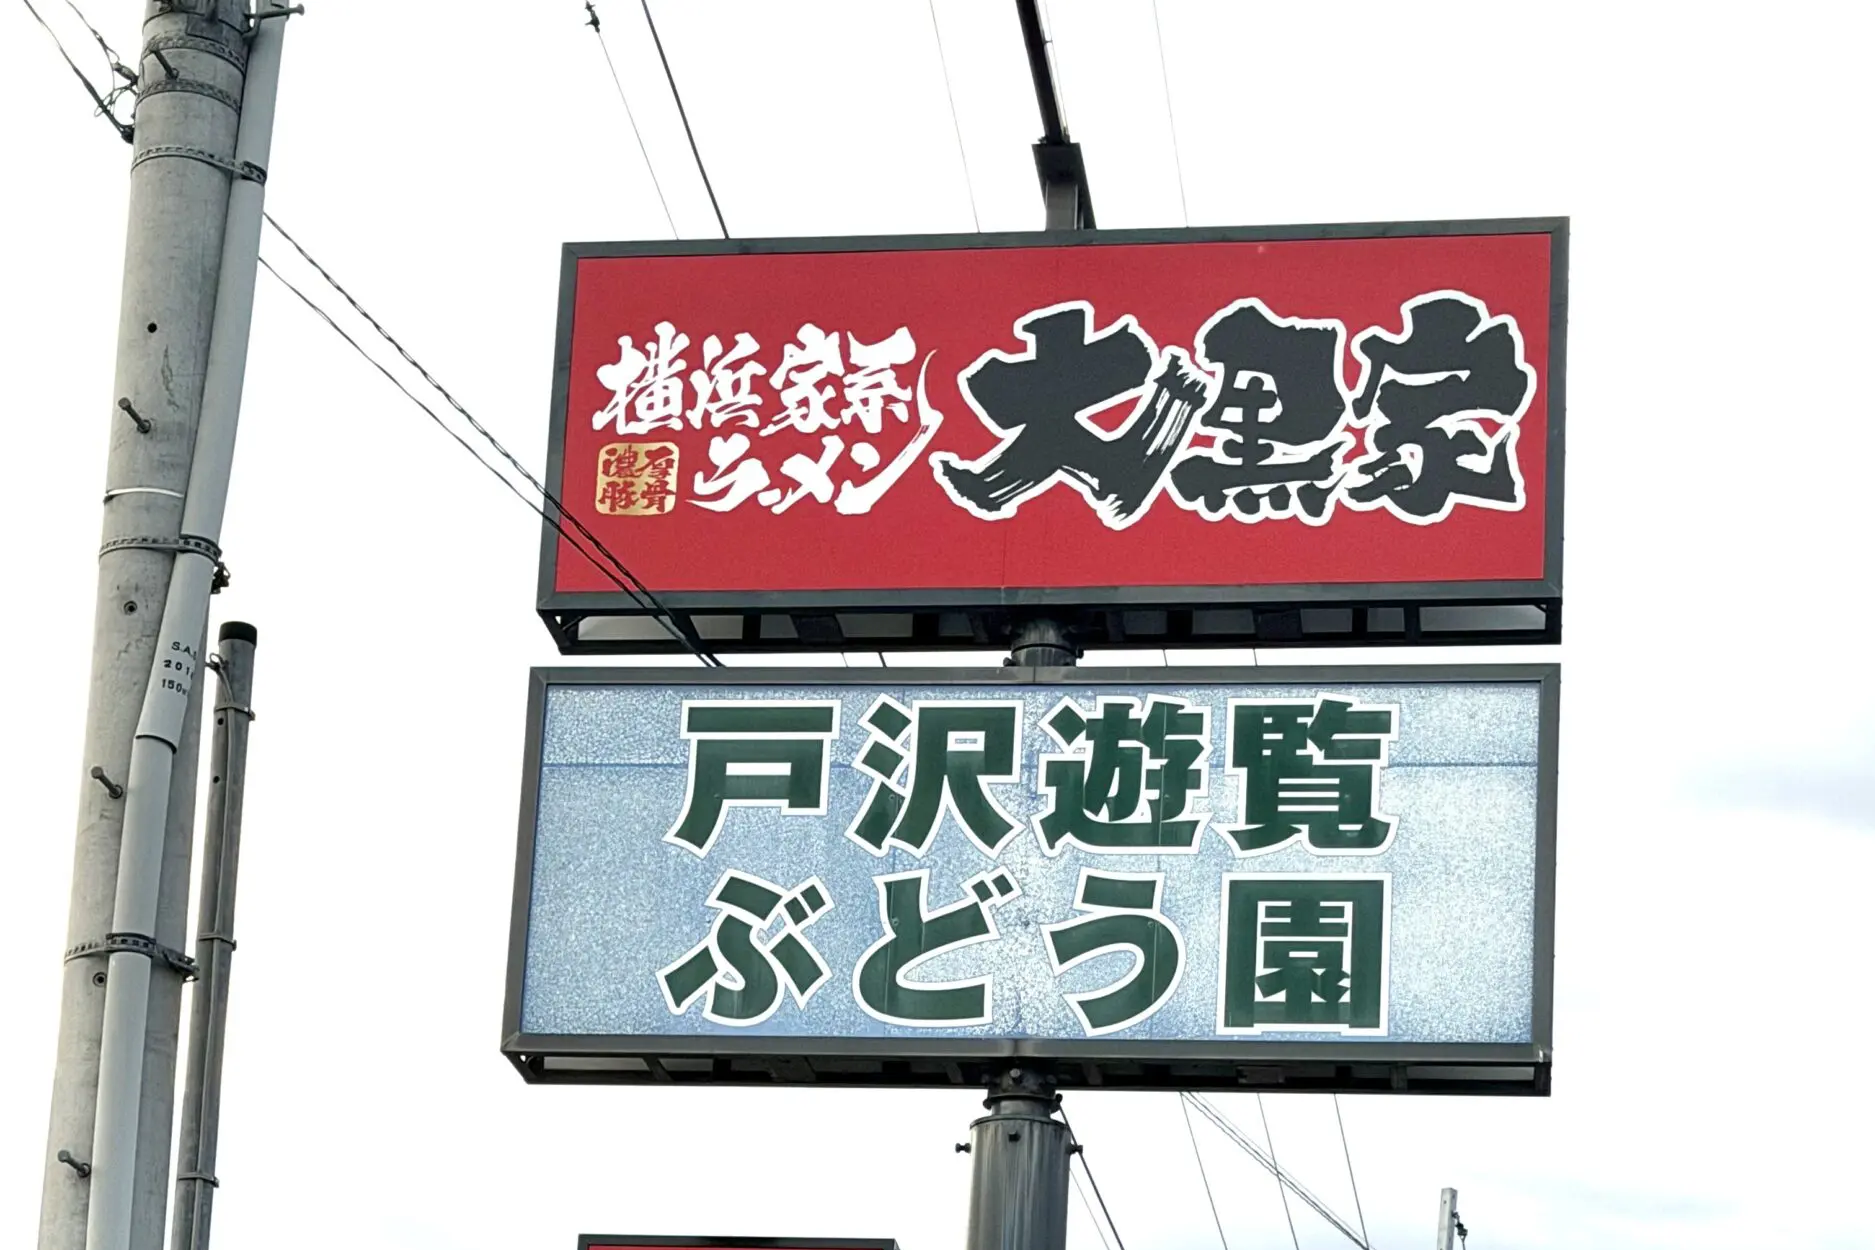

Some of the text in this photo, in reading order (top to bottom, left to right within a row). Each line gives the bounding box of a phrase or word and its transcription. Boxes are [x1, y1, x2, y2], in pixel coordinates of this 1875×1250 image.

[930, 290, 1535, 530] 大黒家
[663, 694, 1398, 857] 戸沢遊覧
[656, 868, 1392, 1038] ぶどう園
